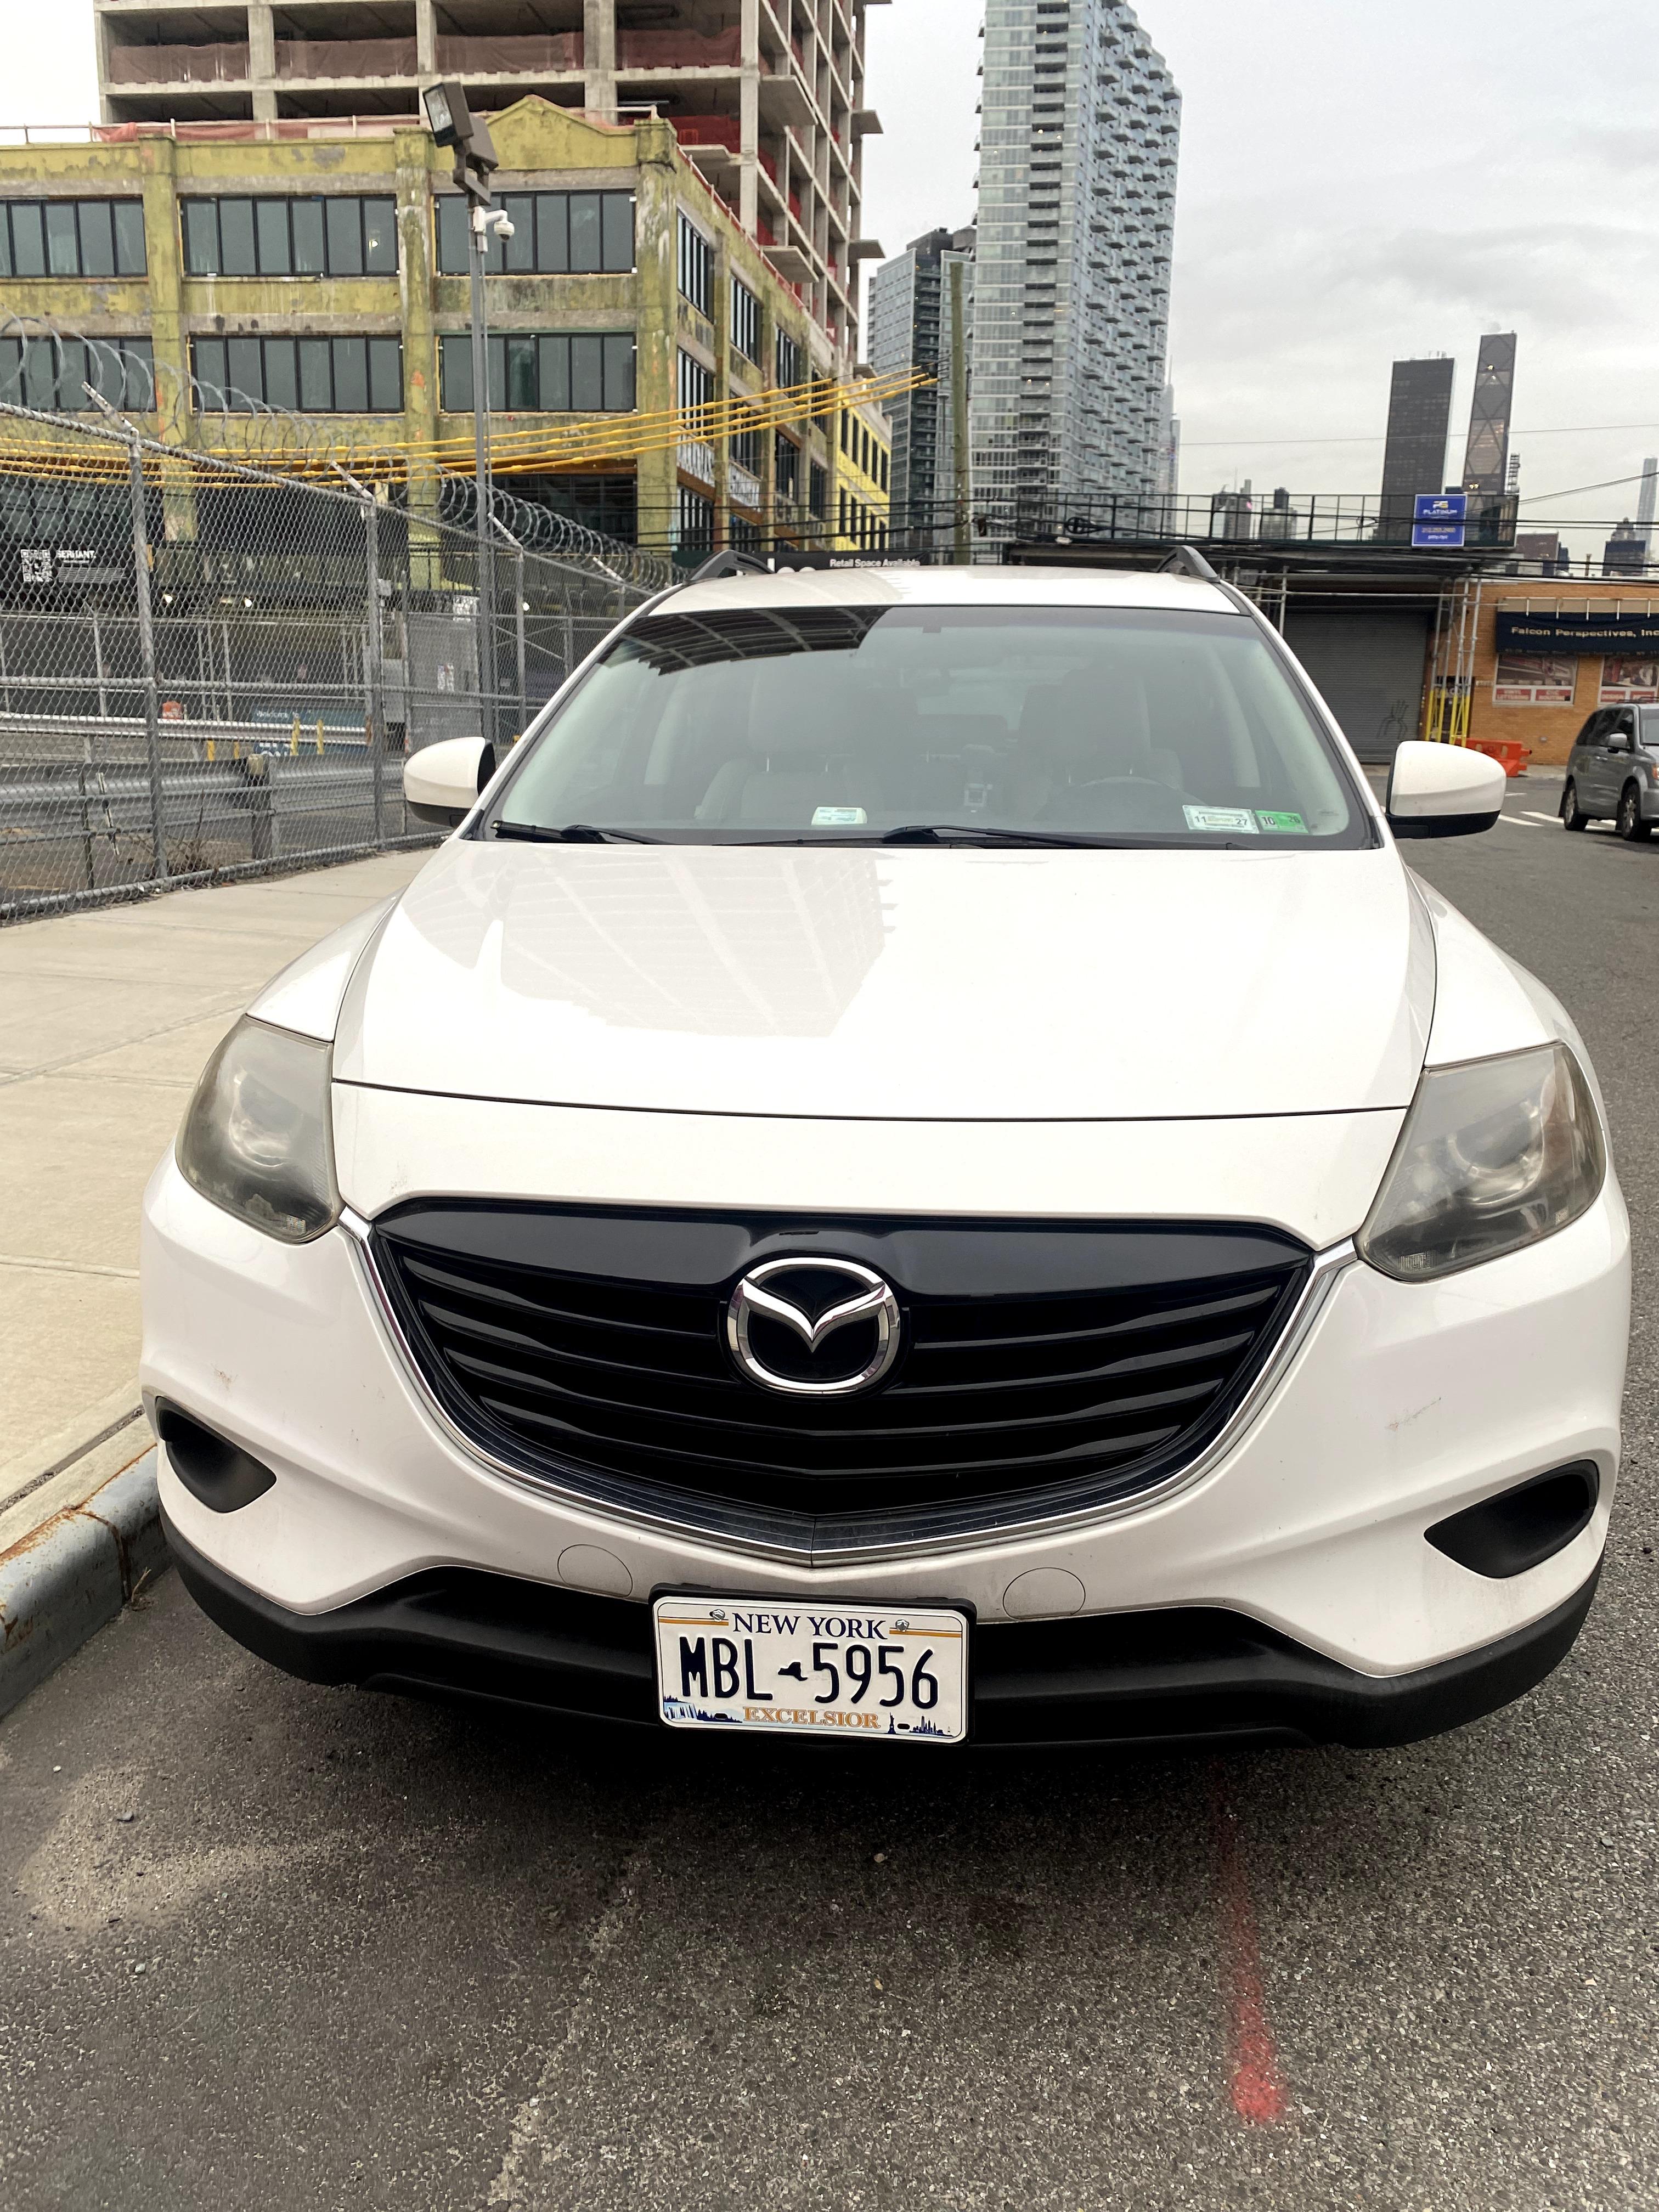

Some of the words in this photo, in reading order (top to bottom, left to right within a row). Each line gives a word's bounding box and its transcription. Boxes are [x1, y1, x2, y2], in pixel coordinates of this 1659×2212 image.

[830, 558, 854, 567] Retail
[855, 558, 882, 568] Space
[882, 558, 921, 567] Available
[1511, 627, 1551, 635] Falcon
[1555, 629, 1637, 638] Perspectives,
[1261, 816, 1276, 825] 10
[732, 1612, 800, 1635] NEW
[806, 1617, 888, 1640] YORK
[679, 1636, 774, 1701] MBL
[812, 1642, 939, 1709] 5956
[742, 1706, 882, 1729] EXCELSIOR
